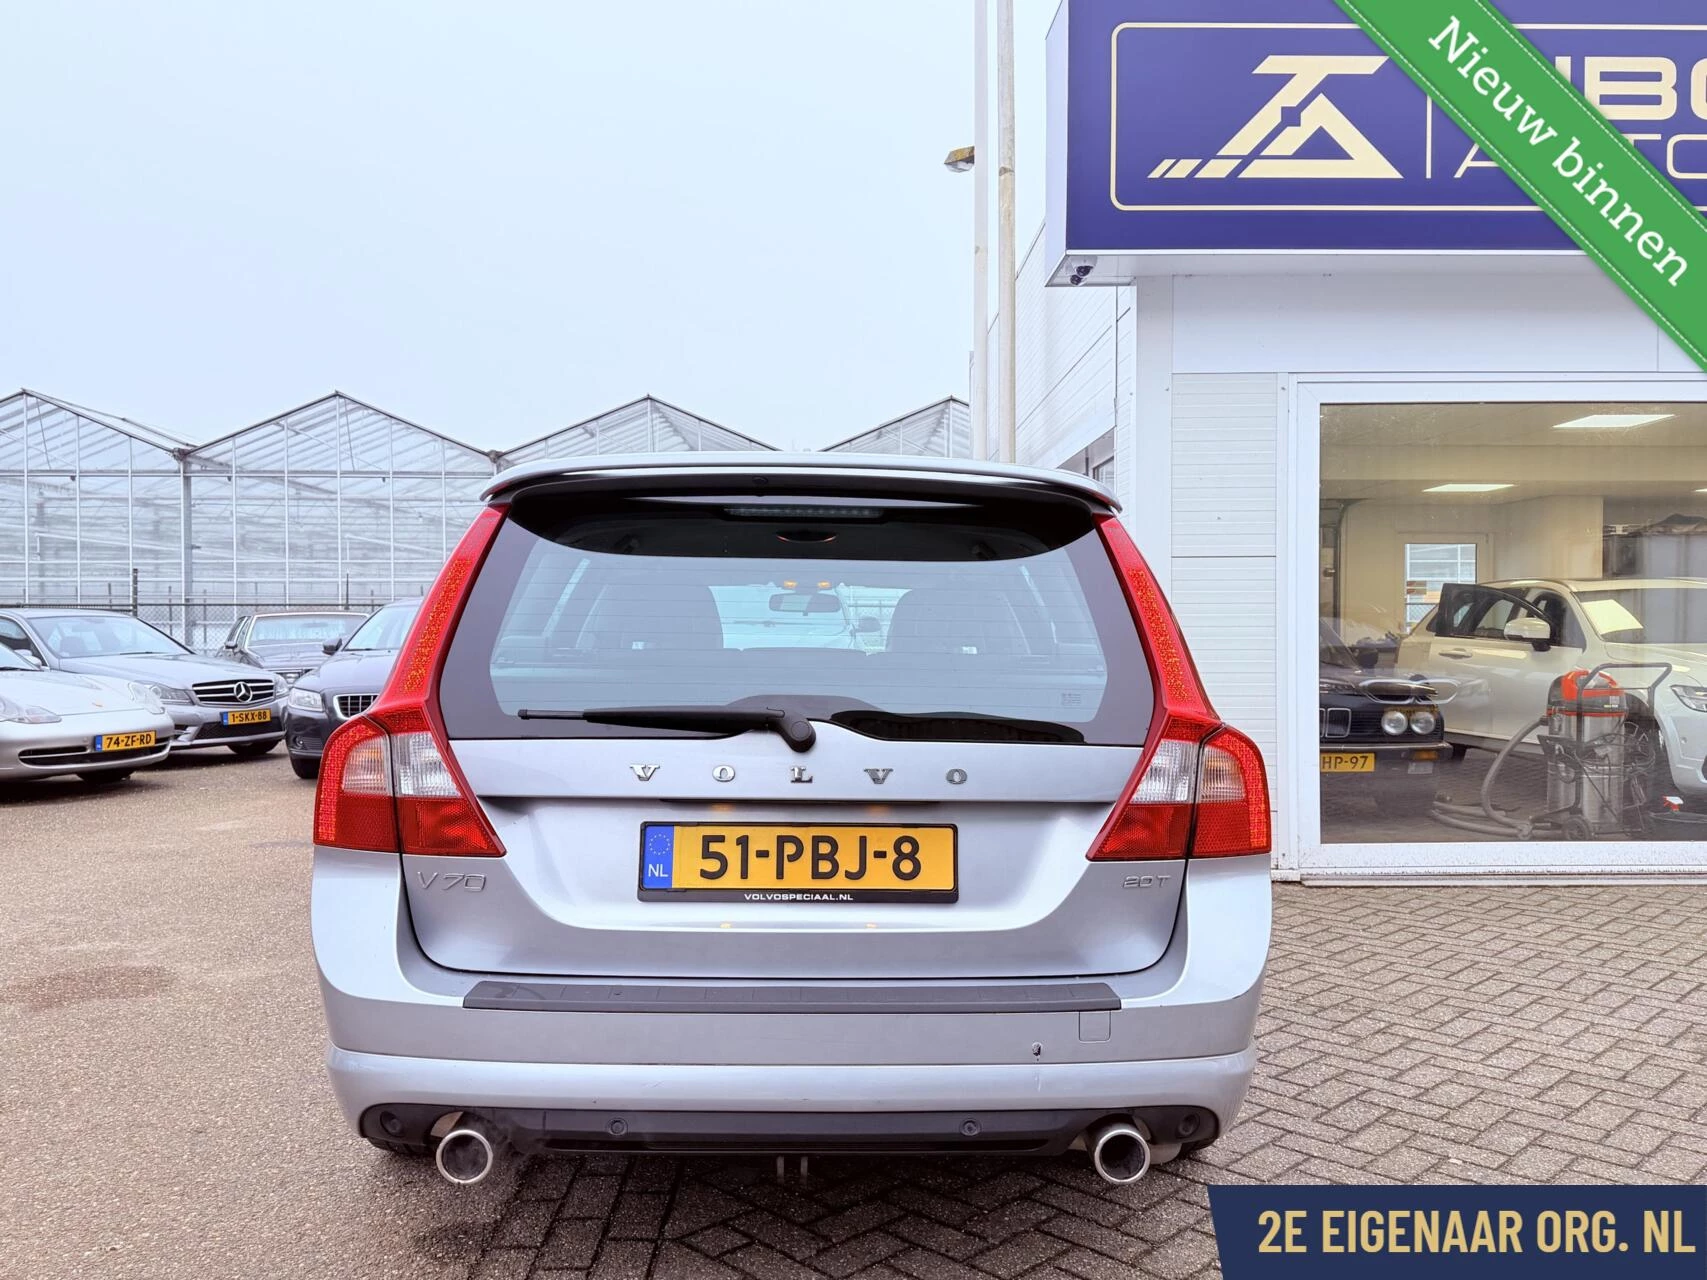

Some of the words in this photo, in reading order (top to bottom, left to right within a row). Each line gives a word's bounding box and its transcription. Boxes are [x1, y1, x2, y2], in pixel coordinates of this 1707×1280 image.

[231, 711, 267, 724] 1-SKX-88
[106, 733, 152, 749] 74-ZF-RD
[630, 764, 968, 785] VOLVO
[648, 863, 669, 877] NL
[700, 834, 922, 881] 51-PBJ-8
[744, 893, 854, 901] VOLVOSPECIAAL.NL
